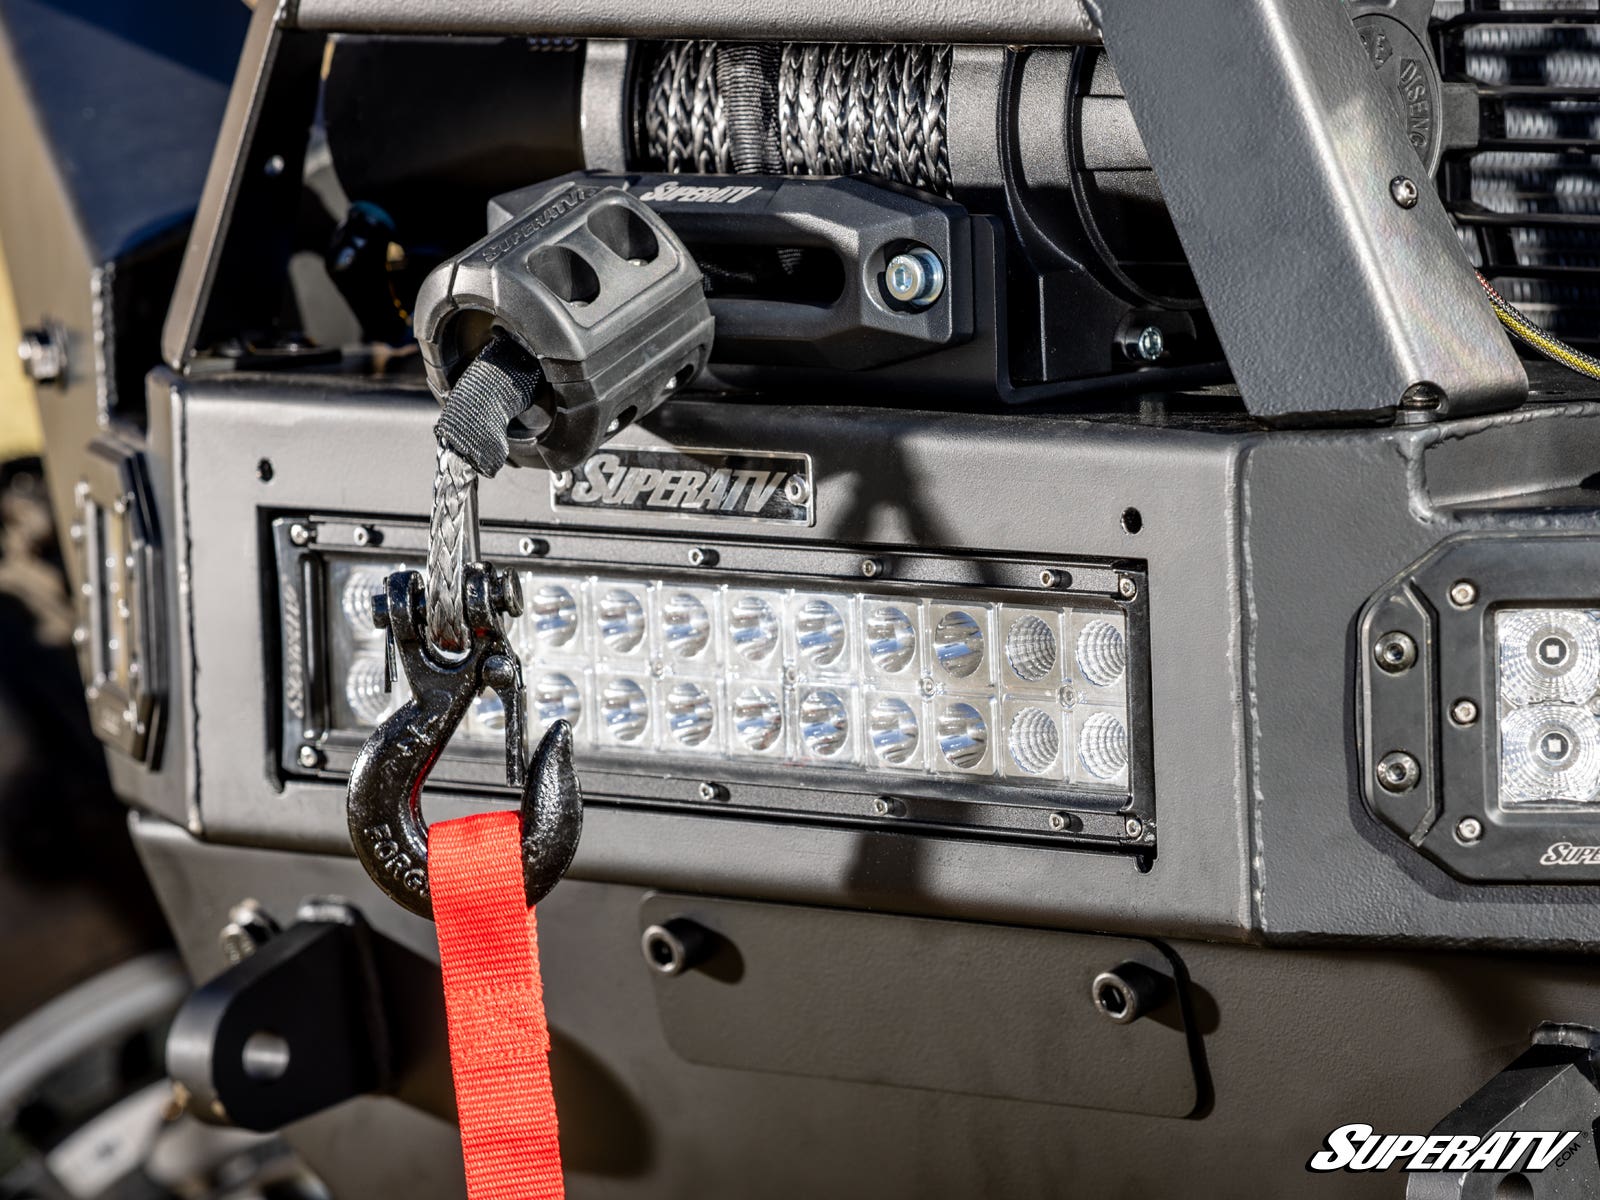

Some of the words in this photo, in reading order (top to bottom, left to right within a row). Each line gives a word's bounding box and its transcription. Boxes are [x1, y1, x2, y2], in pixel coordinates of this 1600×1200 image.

[639, 181, 763, 204] SUPERATV
[571, 453, 788, 513] SUPERATV
[363, 823, 430, 898] FORG
